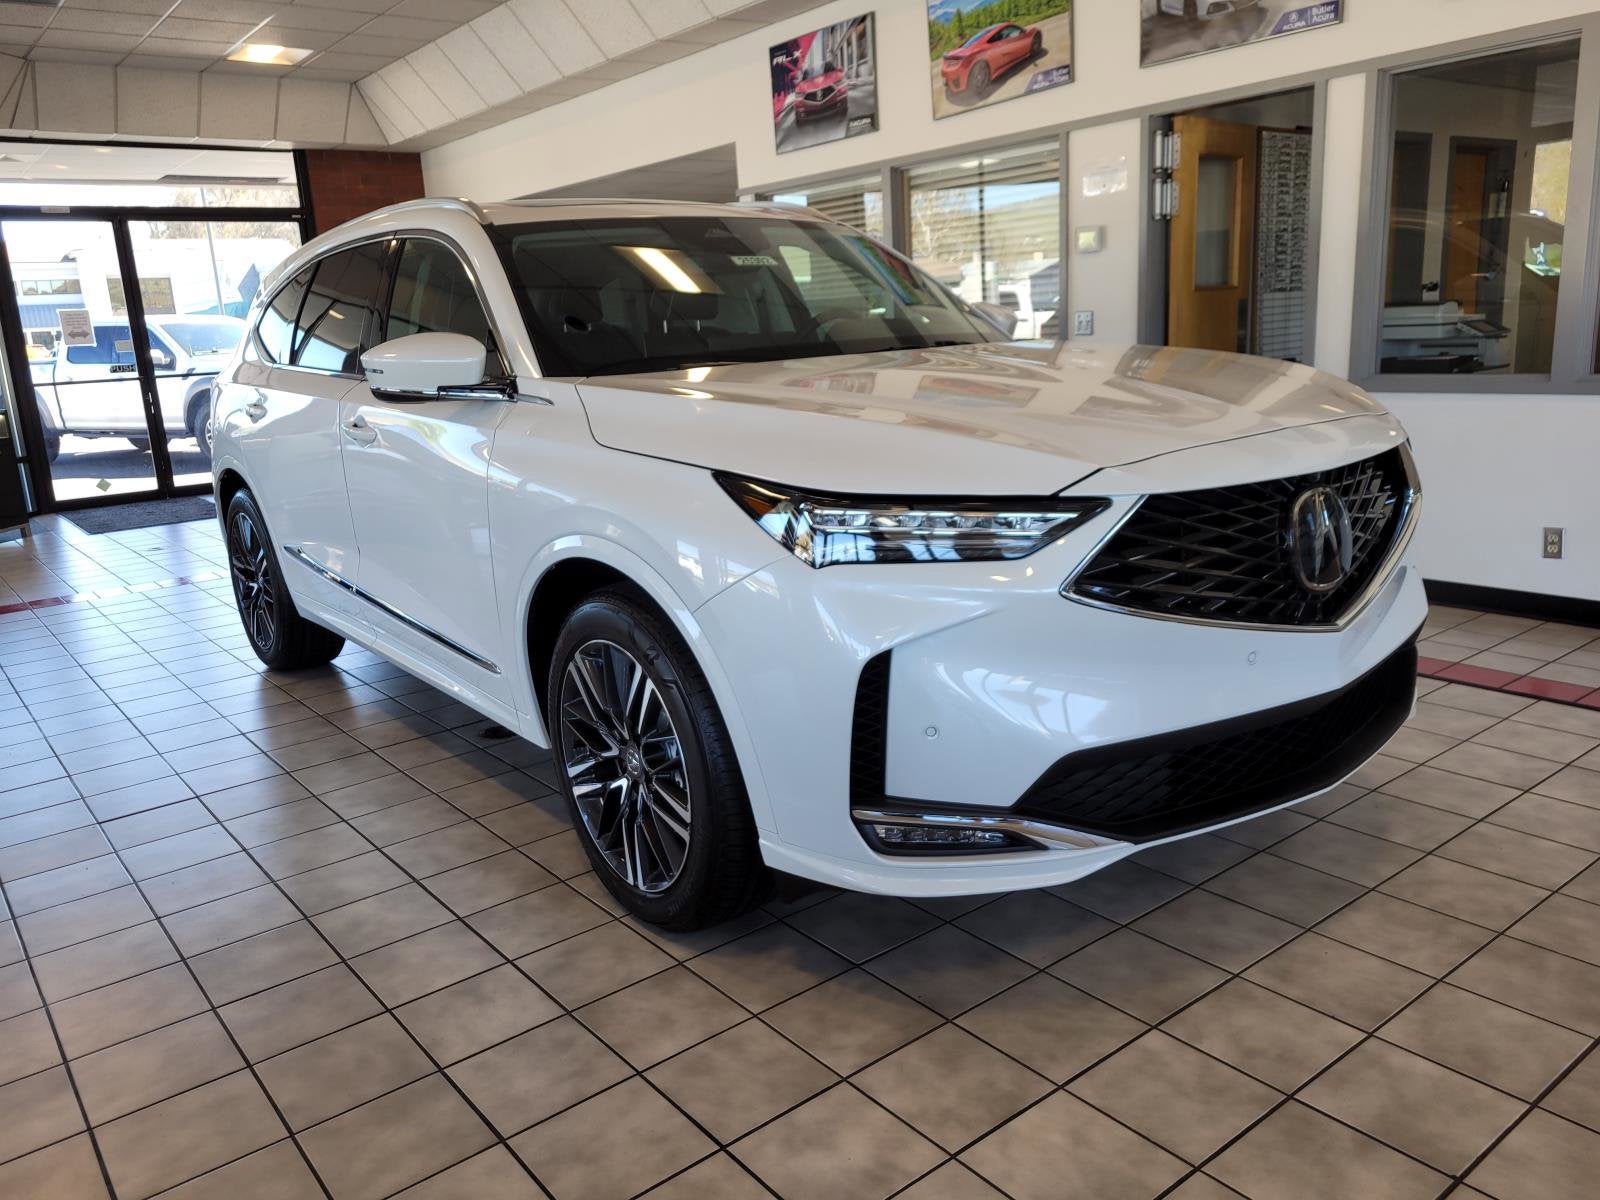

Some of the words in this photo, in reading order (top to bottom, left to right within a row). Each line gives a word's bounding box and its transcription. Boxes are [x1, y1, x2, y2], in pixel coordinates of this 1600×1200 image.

[1312, 4, 1335, 16] Butler
[1312, 13, 1335, 23] Acura
[110, 364, 136, 373] PUSH
